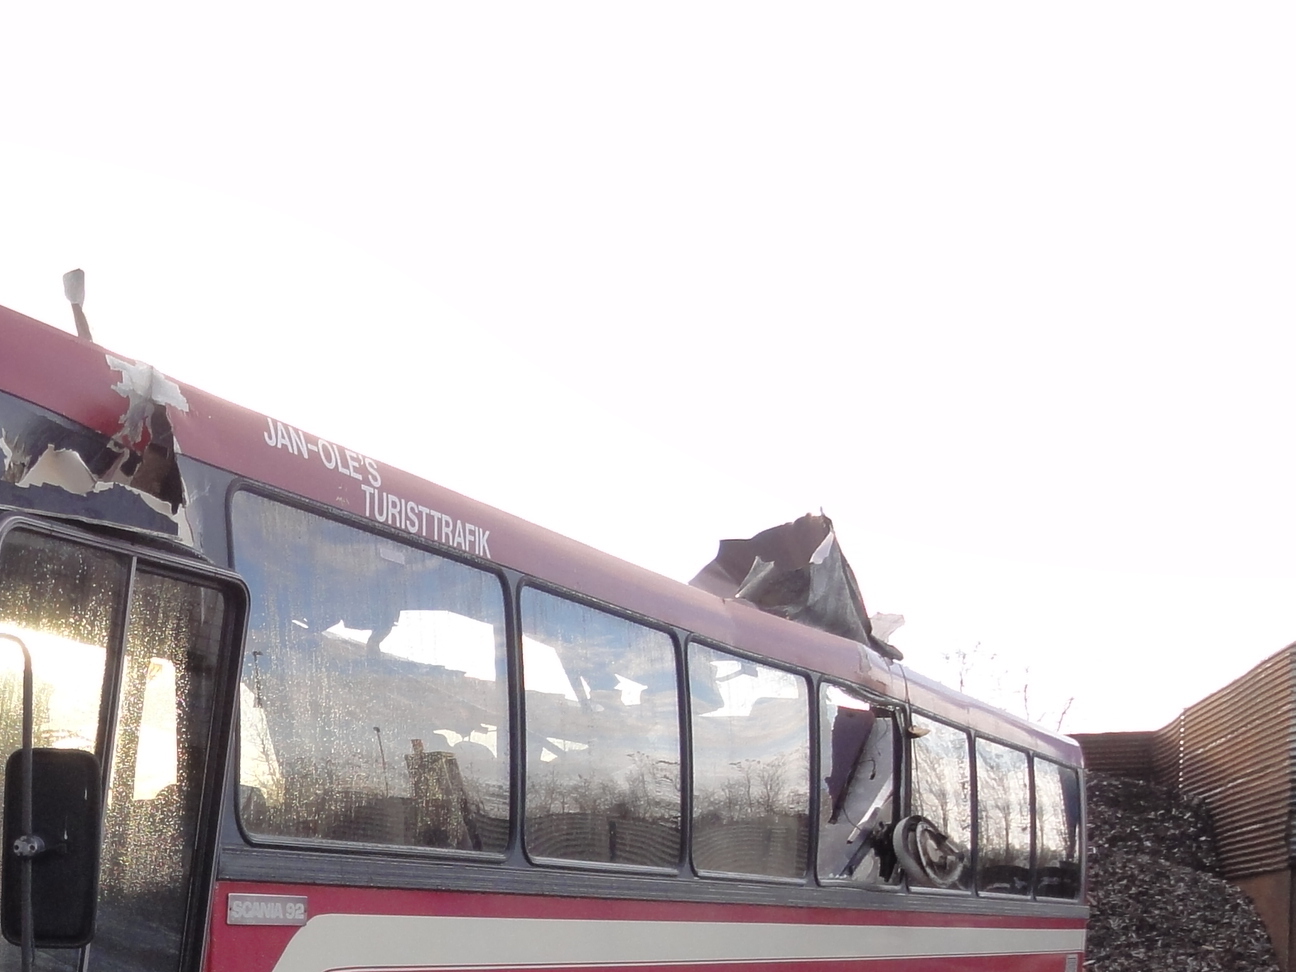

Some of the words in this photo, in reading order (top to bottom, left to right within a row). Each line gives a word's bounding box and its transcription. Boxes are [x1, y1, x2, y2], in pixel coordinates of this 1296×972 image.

[263, 417, 382, 487] JAN-OLE'S
[361, 484, 492, 559] TURISTTRAFIK
[231, 901, 284, 919] SCANIA
[285, 902, 305, 919] 92
